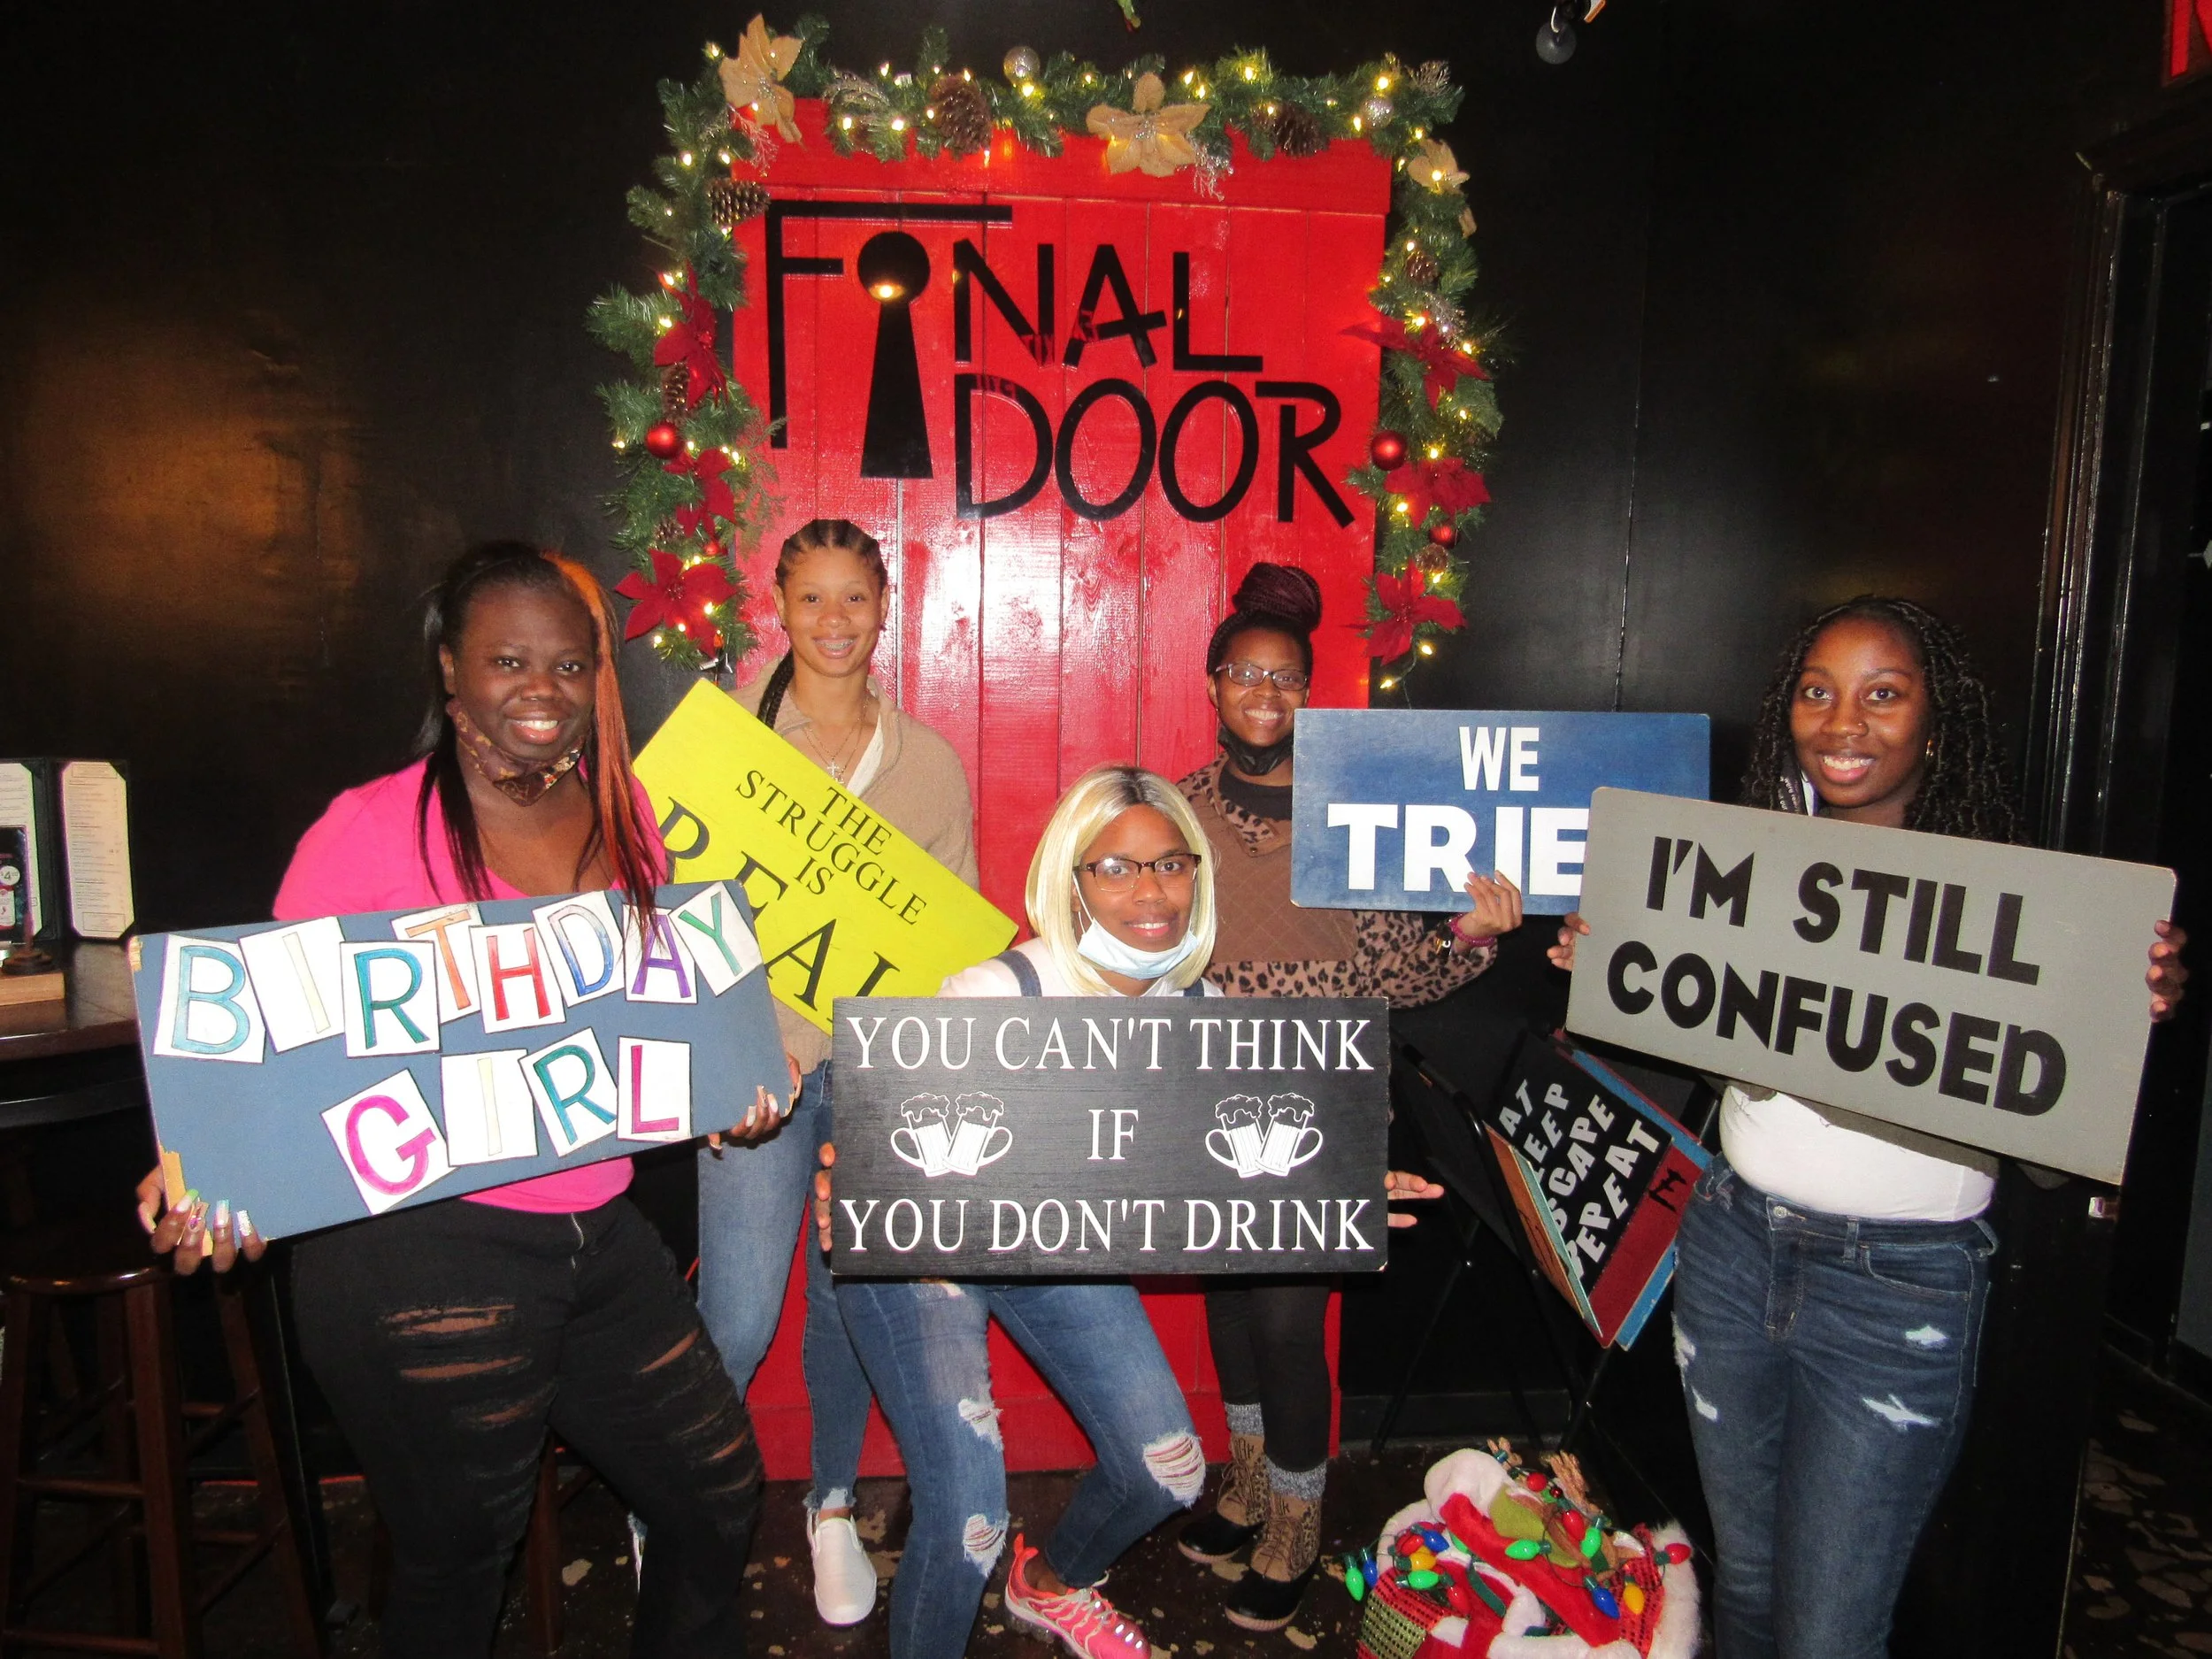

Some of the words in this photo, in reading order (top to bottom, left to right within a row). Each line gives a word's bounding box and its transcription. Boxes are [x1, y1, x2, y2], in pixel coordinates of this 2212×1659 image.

[955, 373, 1355, 528] DOOR
[1459, 726, 1539, 792] WE
[735, 770, 927, 926] STRUGGLE
[794, 856, 835, 895] IS
[818, 787, 892, 856] THE
[1646, 836, 1755, 927] I'M
[1793, 862, 2040, 986] STILL
[171, 891, 745, 1055] BIRTHDAY
[846, 1017, 977, 1071] YOU
[995, 1017, 1171, 1071] CAN'T
[1189, 1018, 1375, 1071] THINK
[1607, 941, 2067, 1117] CONFUSED
[346, 1043, 680, 1196] GIRL
[1087, 1109, 1140, 1161] IF
[839, 1198, 970, 1253] YOU
[988, 1198, 1166, 1253] DON'T
[1183, 1199, 1375, 1252] DRINK
